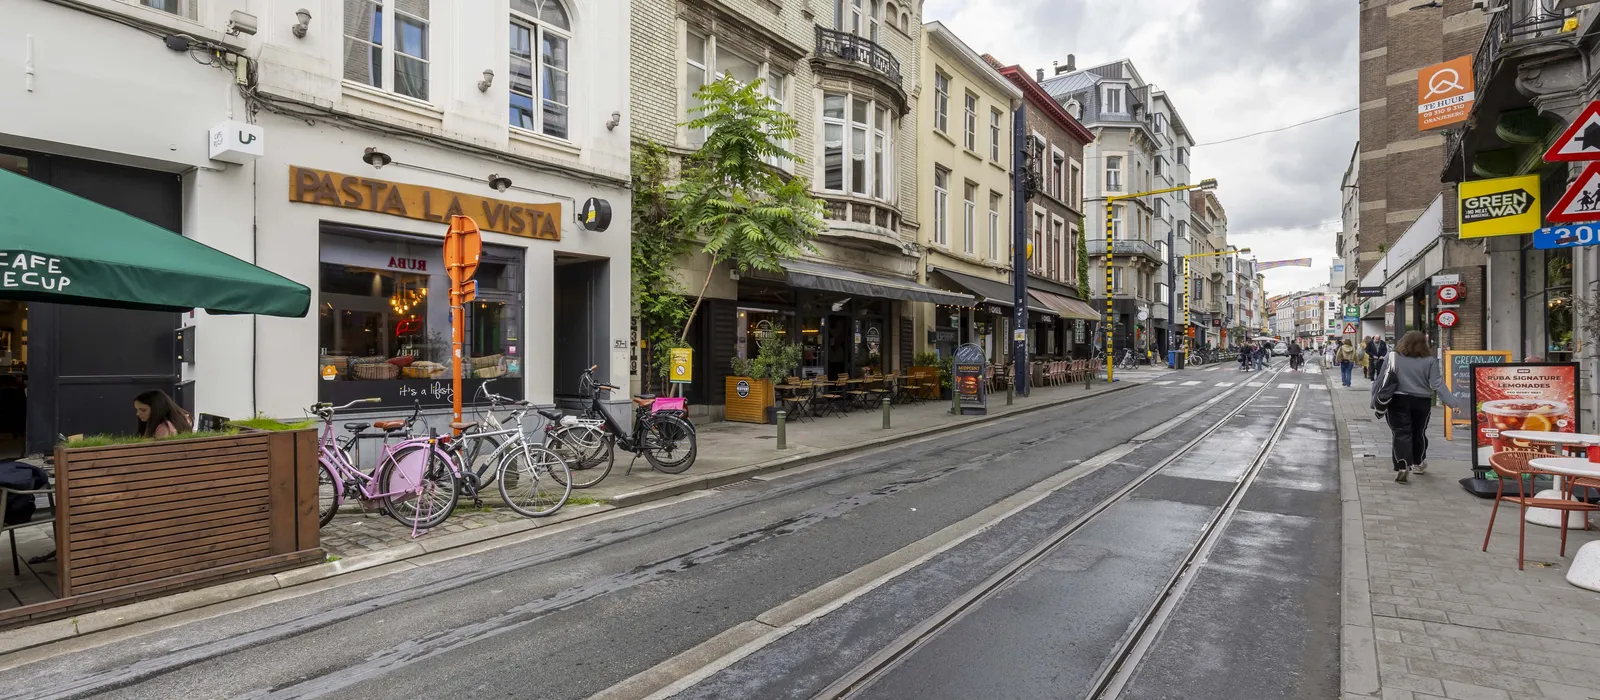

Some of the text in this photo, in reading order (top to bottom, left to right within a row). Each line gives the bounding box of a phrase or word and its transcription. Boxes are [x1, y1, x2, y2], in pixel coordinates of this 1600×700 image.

[1424, 95, 1465, 111] TE HUUR
[1453, 103, 1465, 111] 310
[1424, 110, 1465, 125] ORANJEBERG
[296, 166, 559, 240] PASTA LA VISTA
[1465, 192, 1527, 209] GREEN
[1487, 202, 1527, 218] WAY
[1554, 225, 1600, 247] 30
[400, 385, 418, 397] it's
